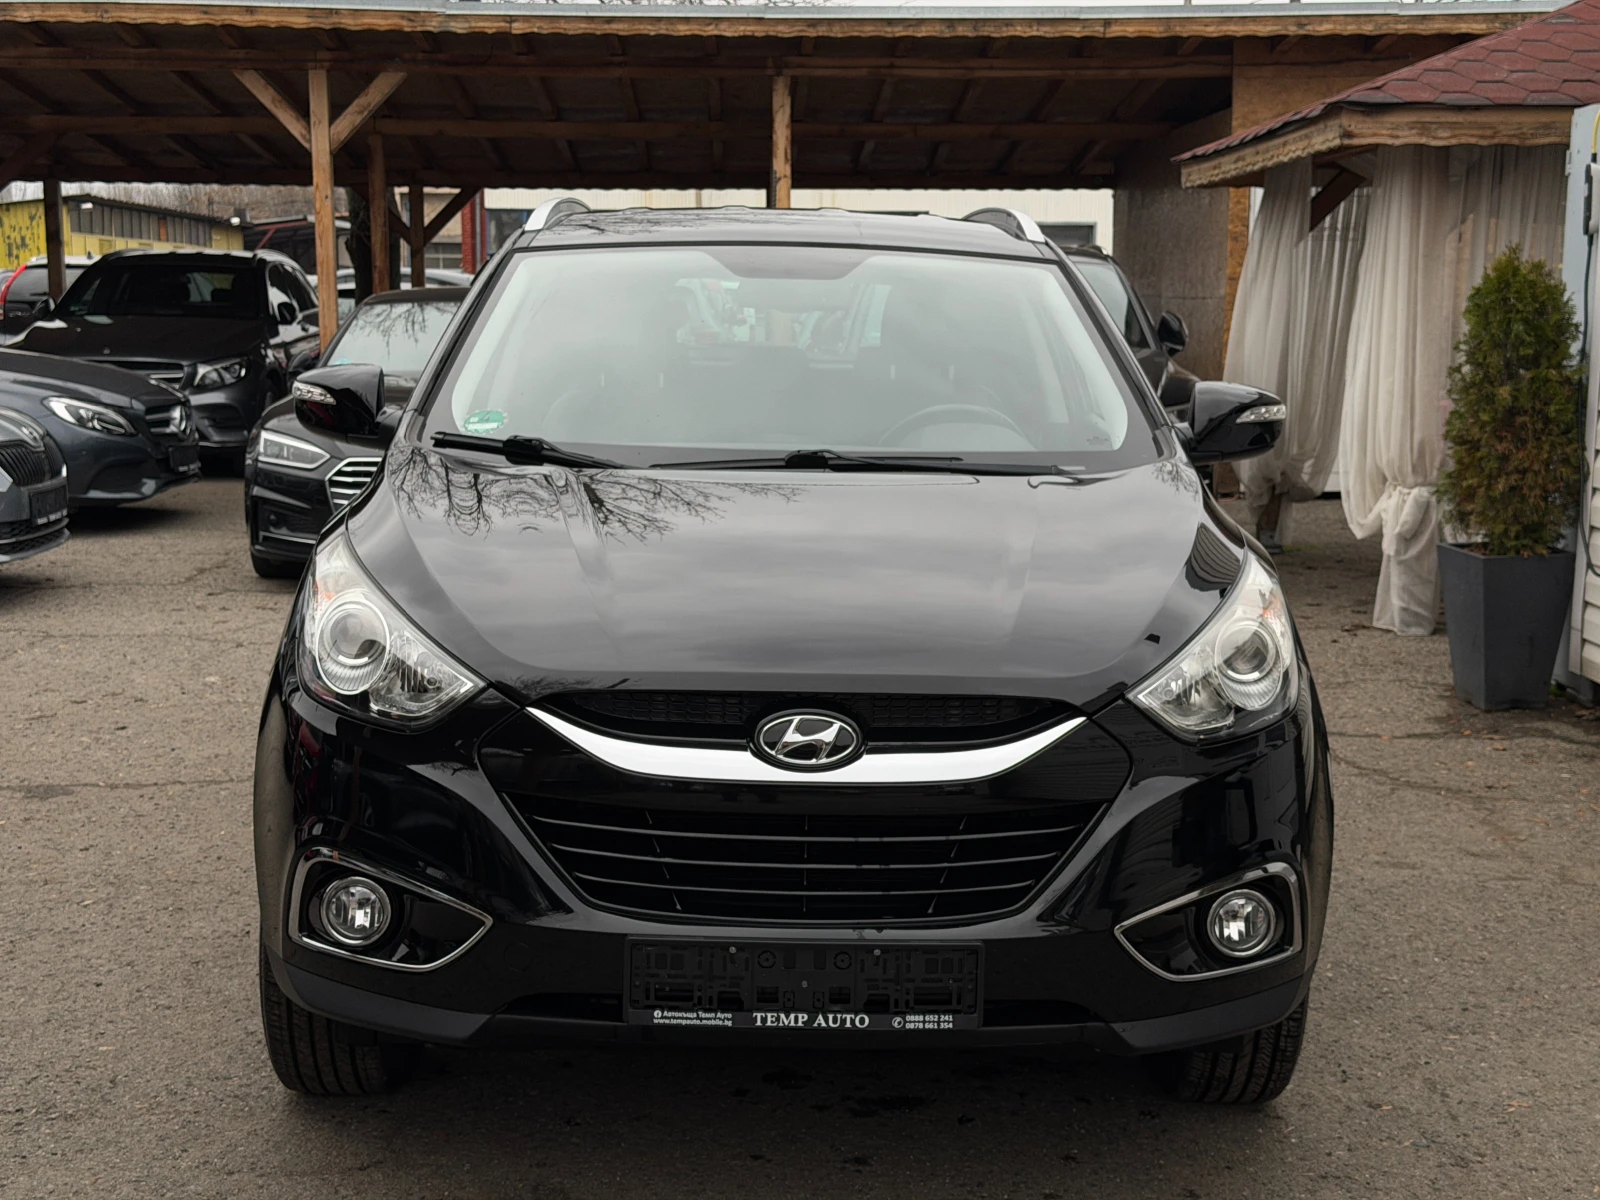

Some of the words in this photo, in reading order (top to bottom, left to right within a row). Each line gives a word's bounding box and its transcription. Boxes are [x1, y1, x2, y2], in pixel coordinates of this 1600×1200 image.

[663, 1010, 697, 1018] Автокъща
[716, 1011, 732, 1019] Ауто
[653, 1018, 732, 1026] www.tempauto.mobile.bg
[752, 1012, 808, 1027] TEMP
[812, 1013, 870, 1028] AUTO
